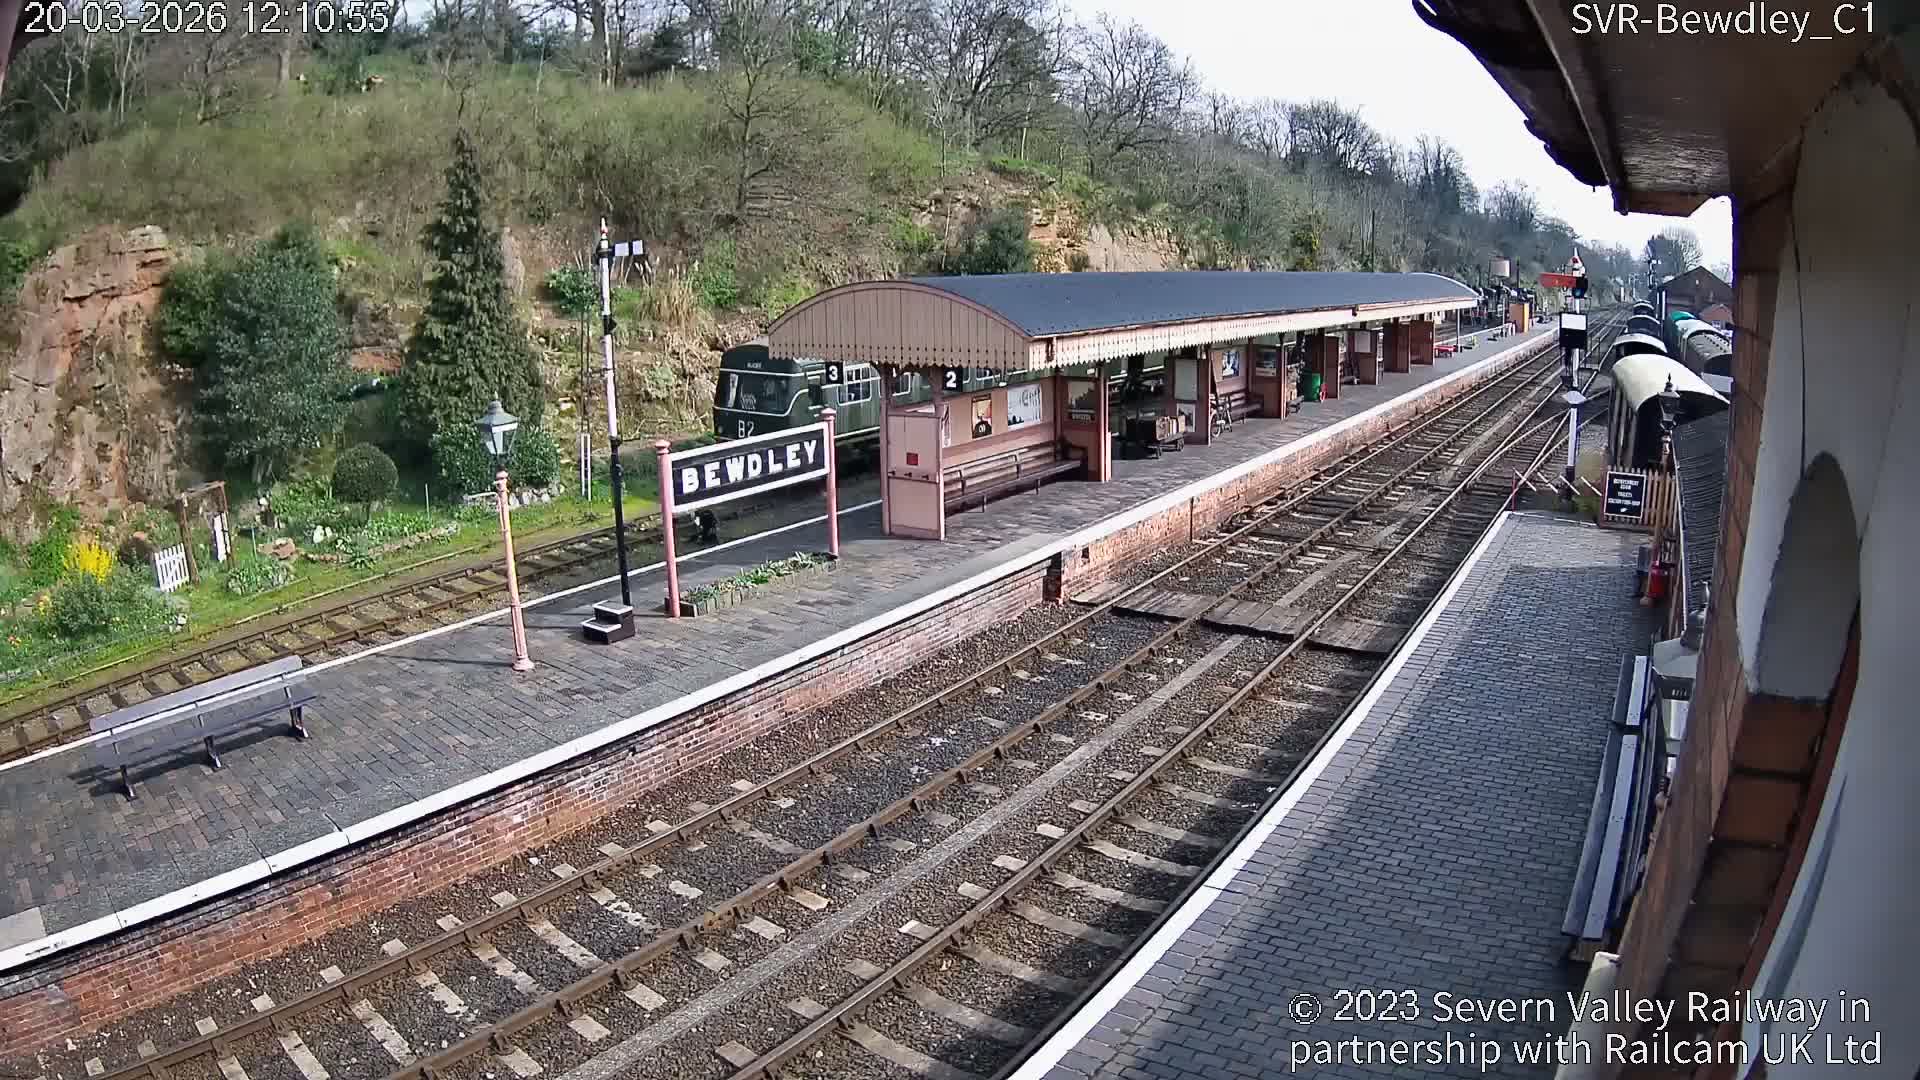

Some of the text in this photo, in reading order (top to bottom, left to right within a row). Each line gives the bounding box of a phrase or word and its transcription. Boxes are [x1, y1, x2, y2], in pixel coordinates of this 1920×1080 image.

[828, 365, 838, 381] 3
[945, 371, 957, 388] 2
[738, 420, 754, 438] B2
[682, 439, 817, 494] BEWDLEY
